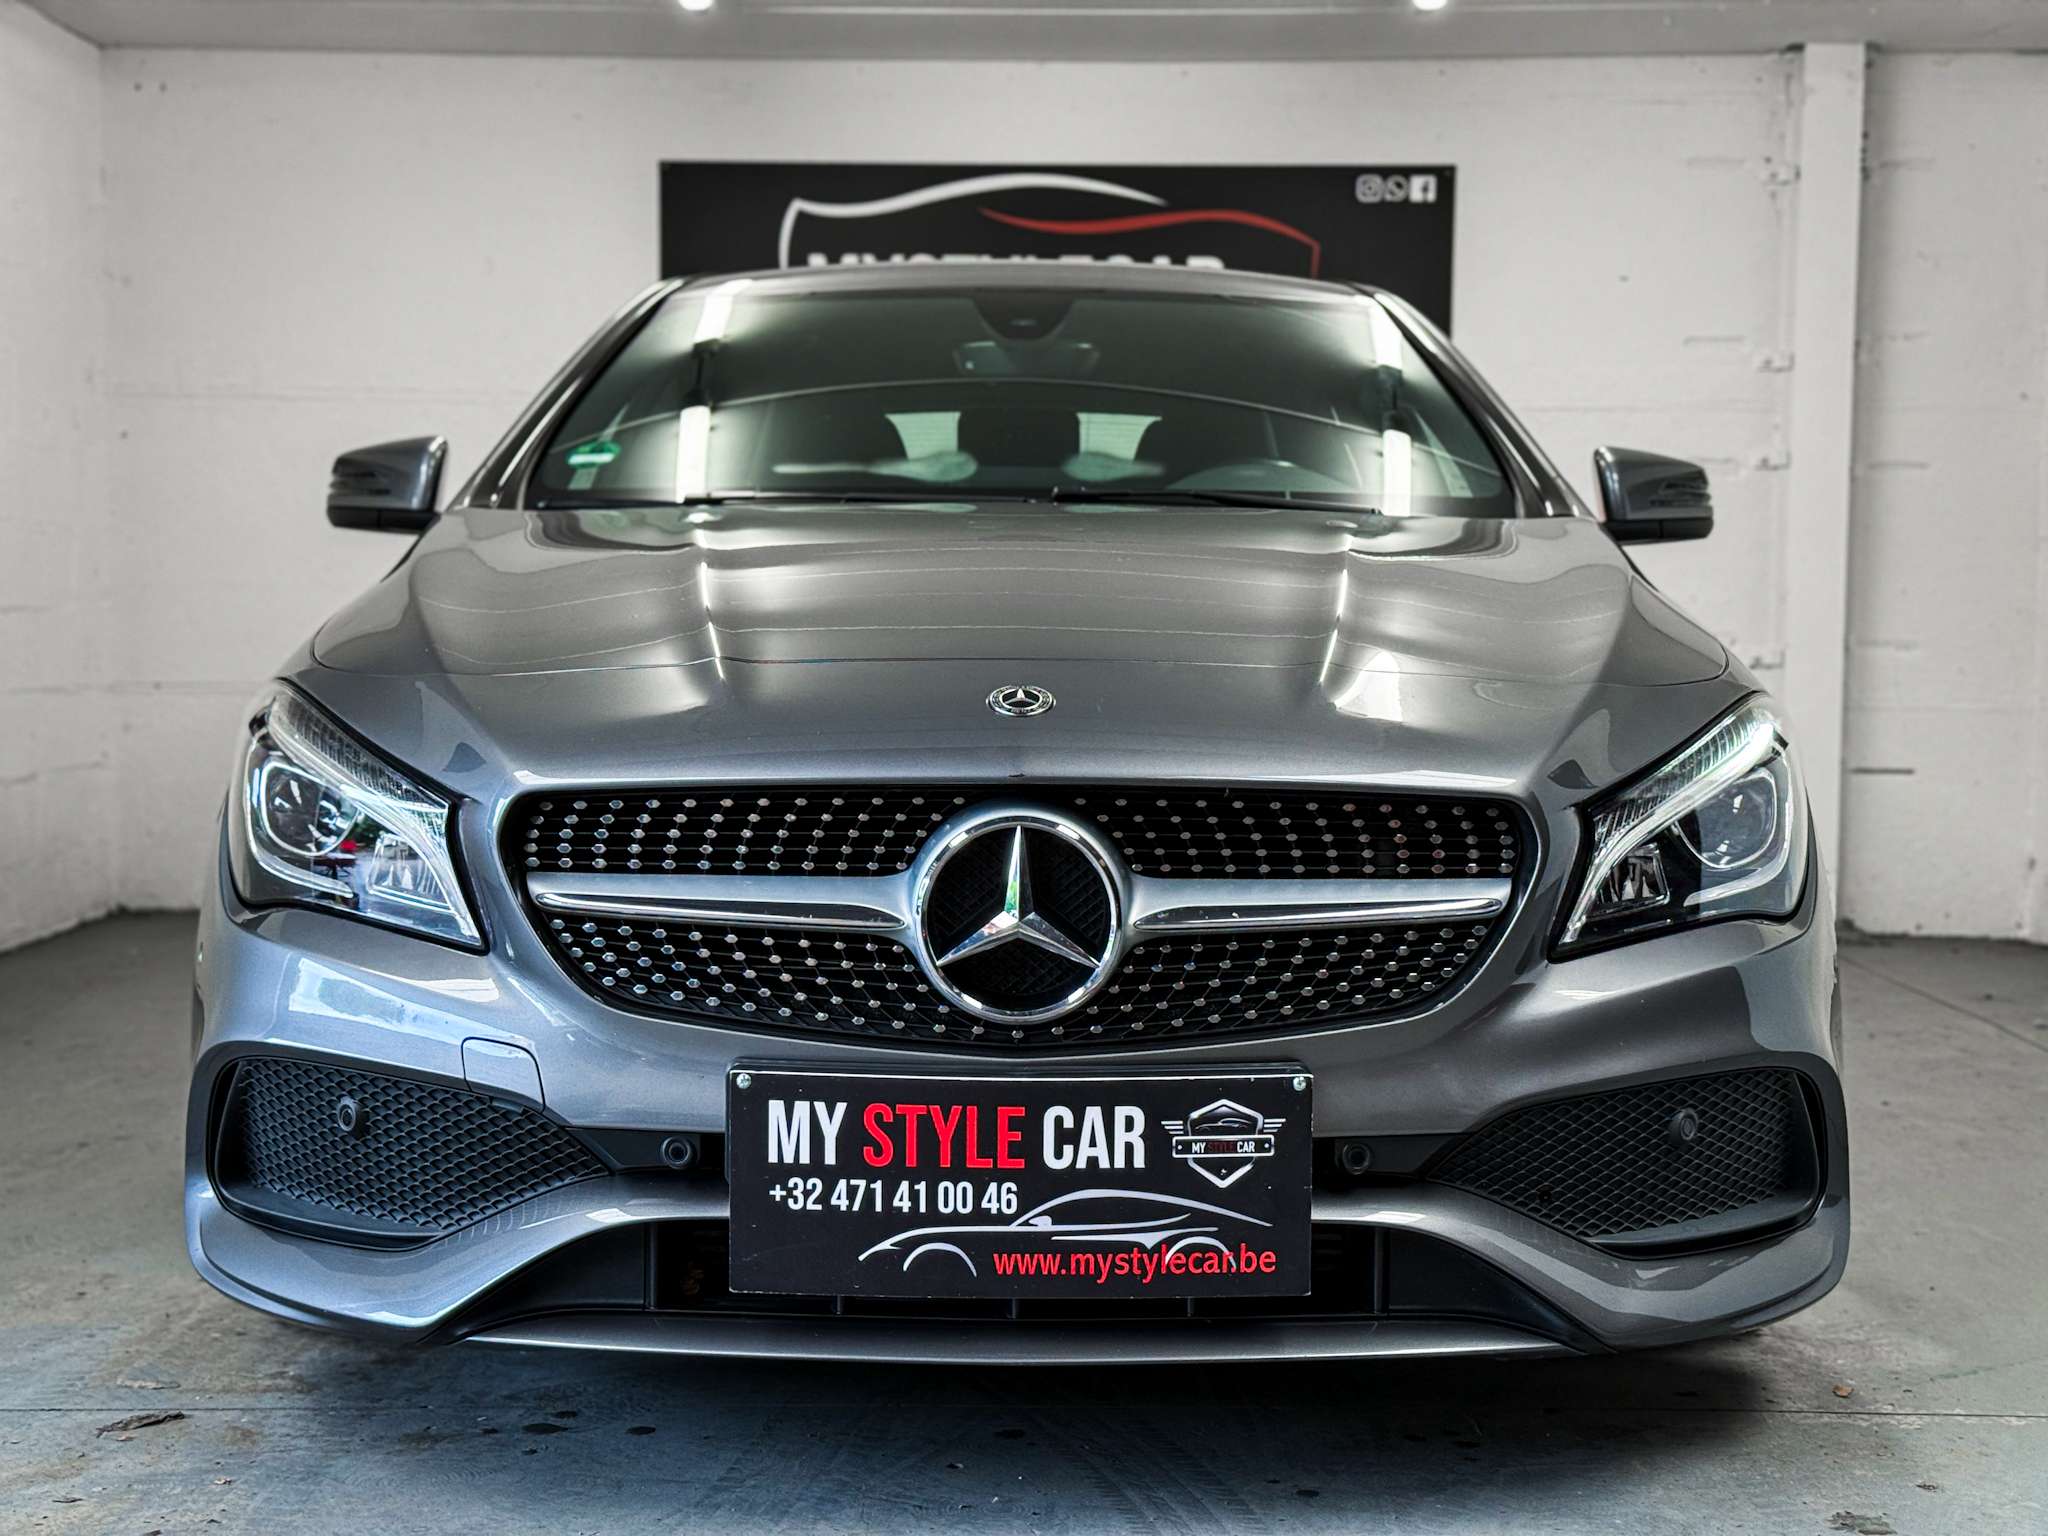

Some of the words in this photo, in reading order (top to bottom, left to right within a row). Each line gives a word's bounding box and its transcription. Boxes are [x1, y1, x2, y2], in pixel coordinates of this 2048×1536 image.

[768, 1100, 847, 1165] MY
[862, 1103, 1026, 1169] STYLE
[1042, 1105, 1146, 1169] CAR
[1191, 1142, 1206, 1154] MY
[1236, 1141, 1255, 1153] CAR
[769, 1176, 823, 1212] +32
[830, 1178, 884, 1213] 471
[892, 1180, 928, 1213] 41
[937, 1181, 973, 1214] 00
[981, 1182, 1018, 1215] 46
[993, 1243, 1277, 1284] www.mystylecar.be
